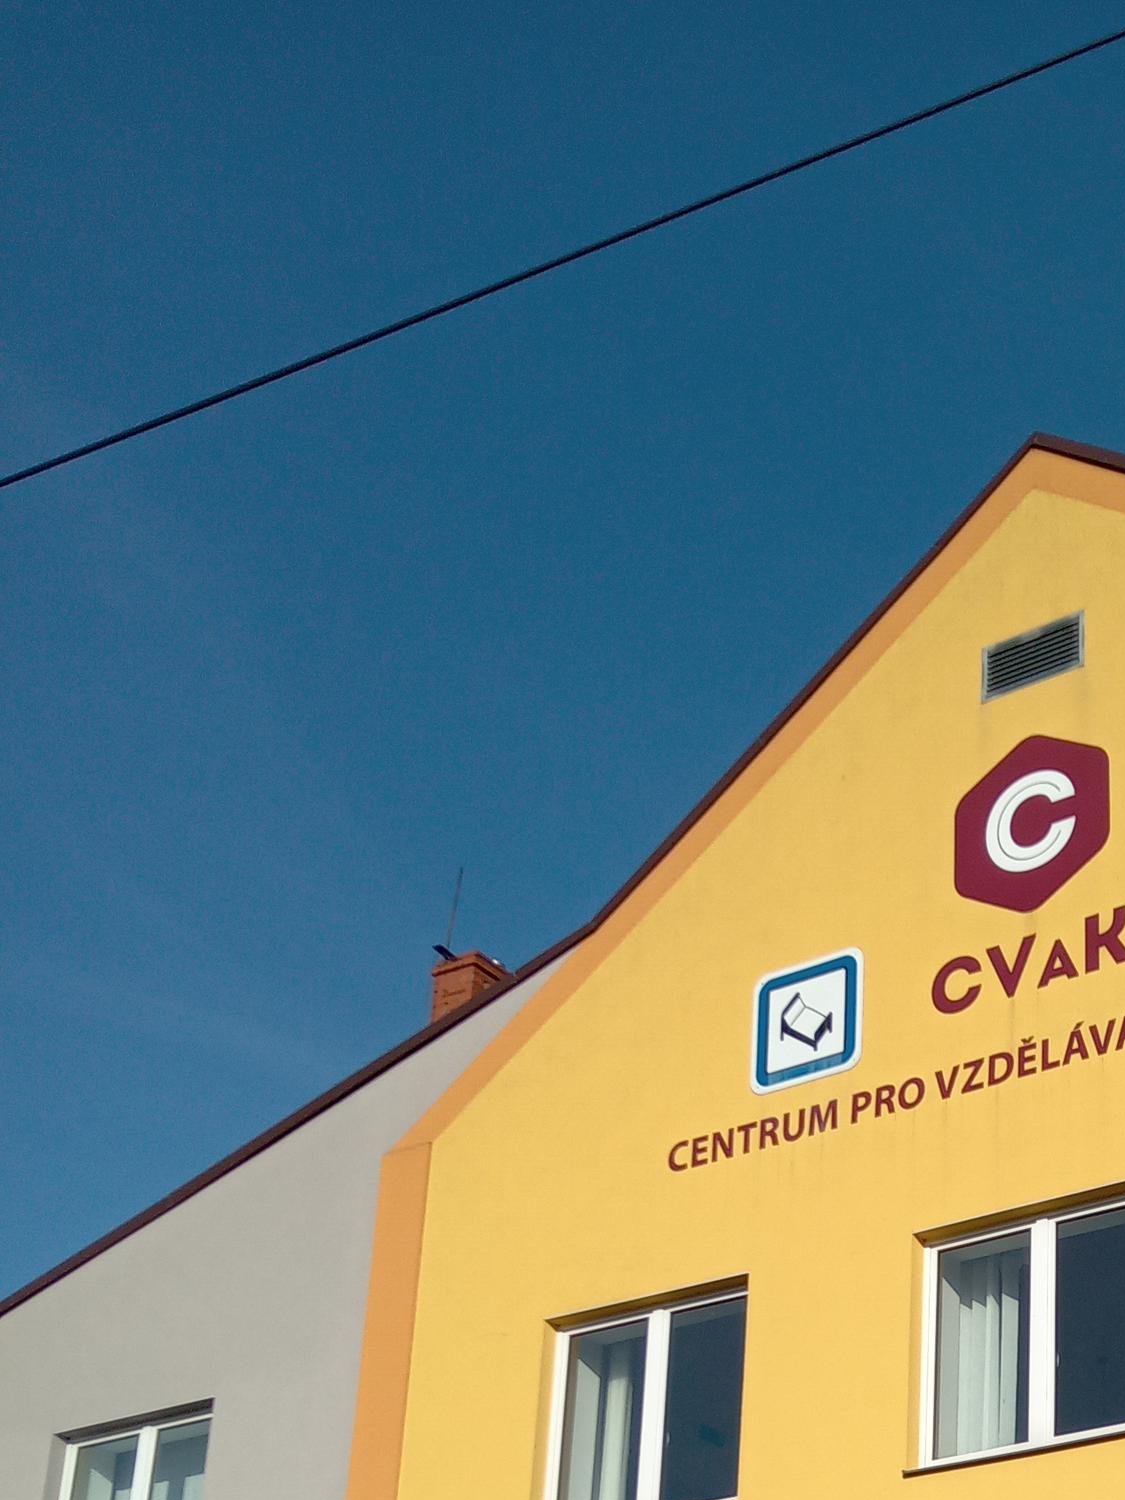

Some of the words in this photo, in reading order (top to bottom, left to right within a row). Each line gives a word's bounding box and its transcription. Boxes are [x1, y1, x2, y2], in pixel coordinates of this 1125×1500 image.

[985, 769, 1076, 873] C
[668, 1099, 839, 1172] CENTRUM
[850, 1077, 926, 1125] PRO
